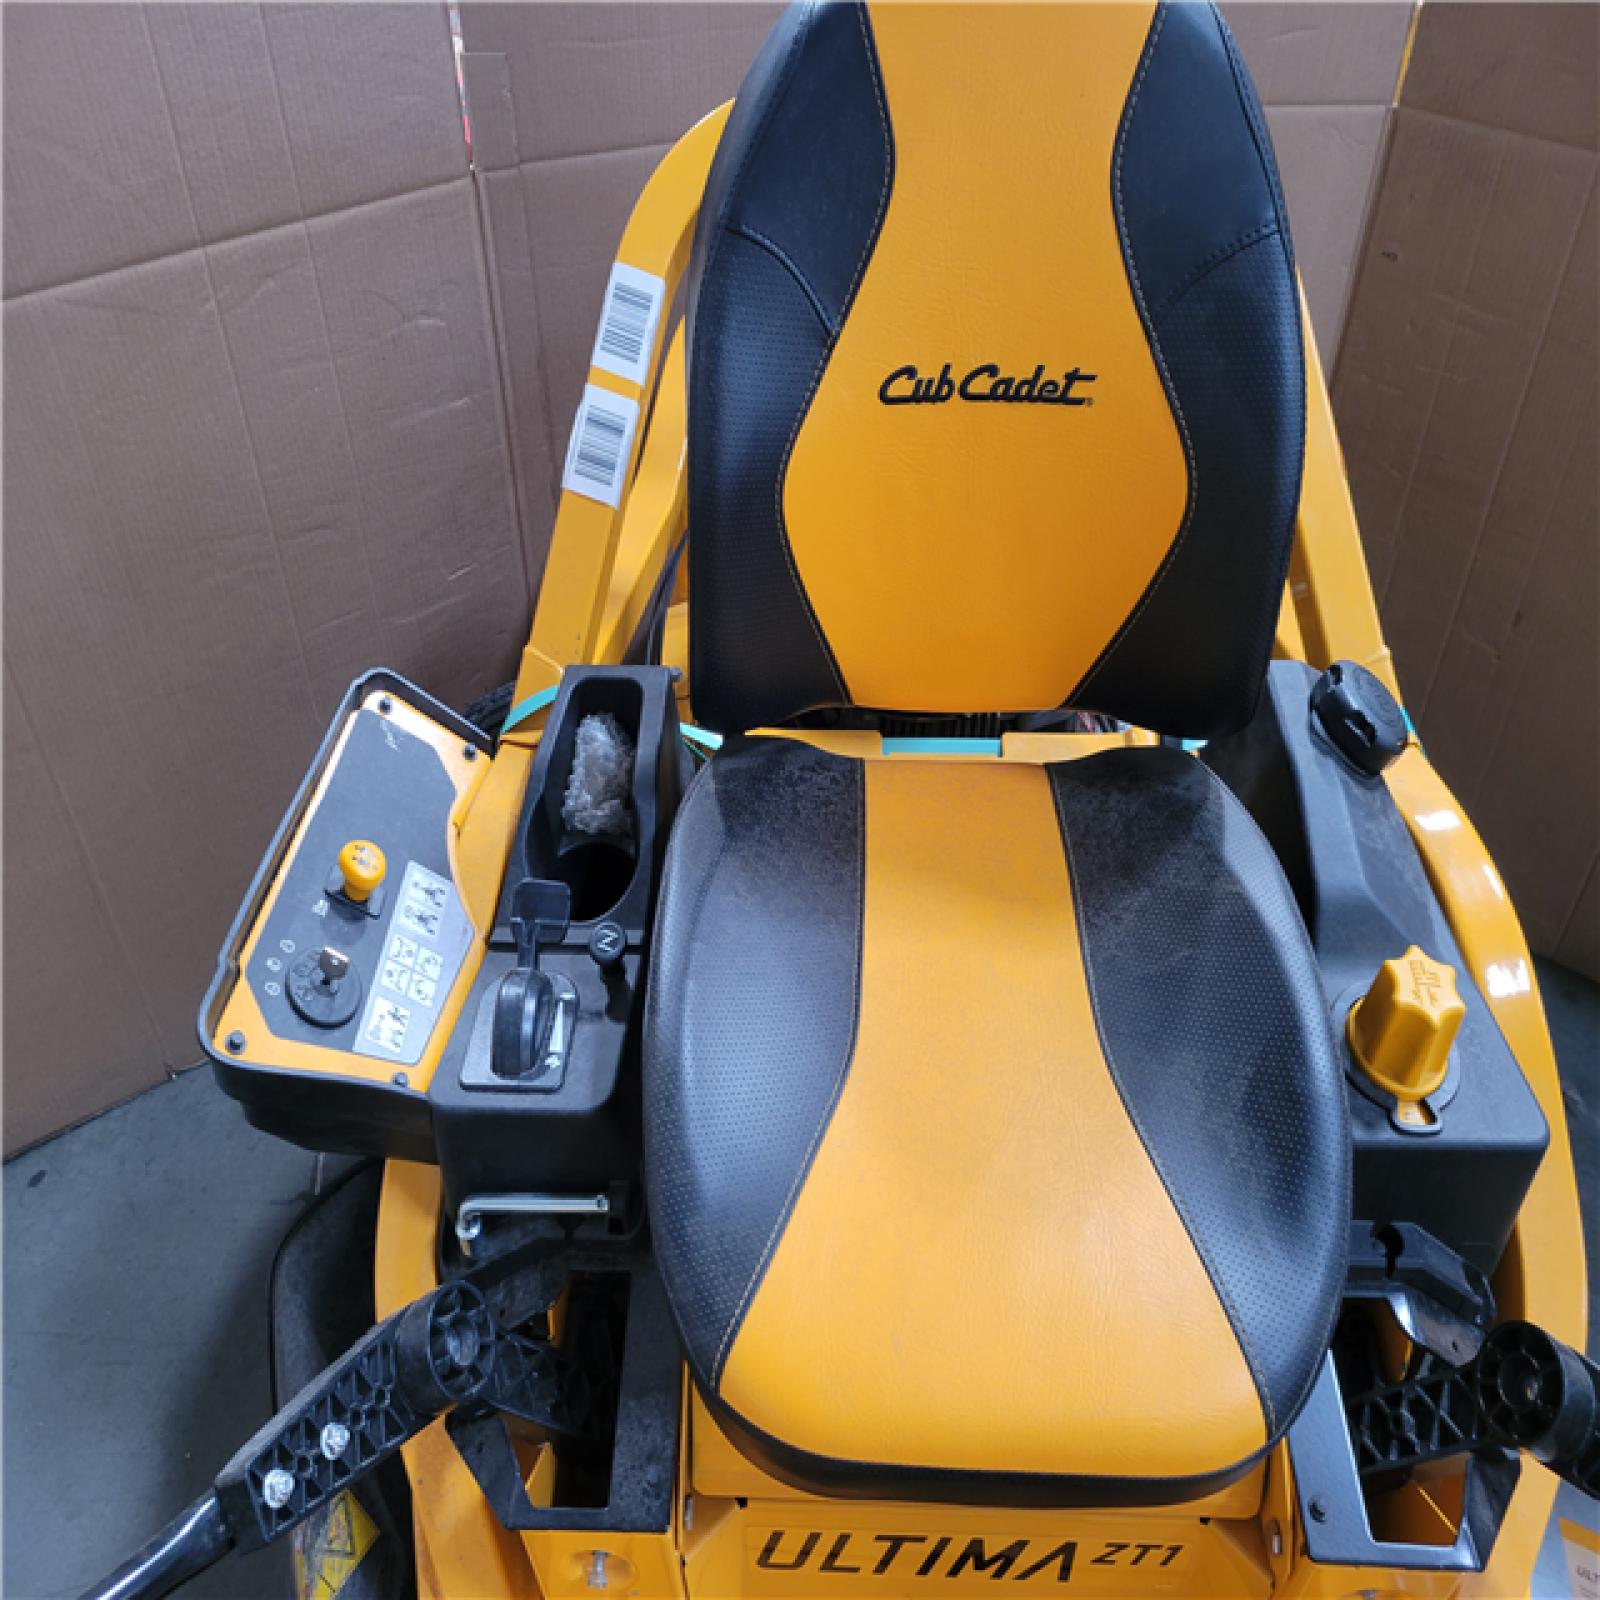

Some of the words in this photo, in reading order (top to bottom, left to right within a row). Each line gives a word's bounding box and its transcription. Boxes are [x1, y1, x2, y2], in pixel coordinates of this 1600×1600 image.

[878, 362, 955, 405] Cub
[958, 363, 1097, 405] Cadet
[756, 1530, 1078, 1583] ULTIMA
[1089, 1542, 1184, 1567] ZT1
